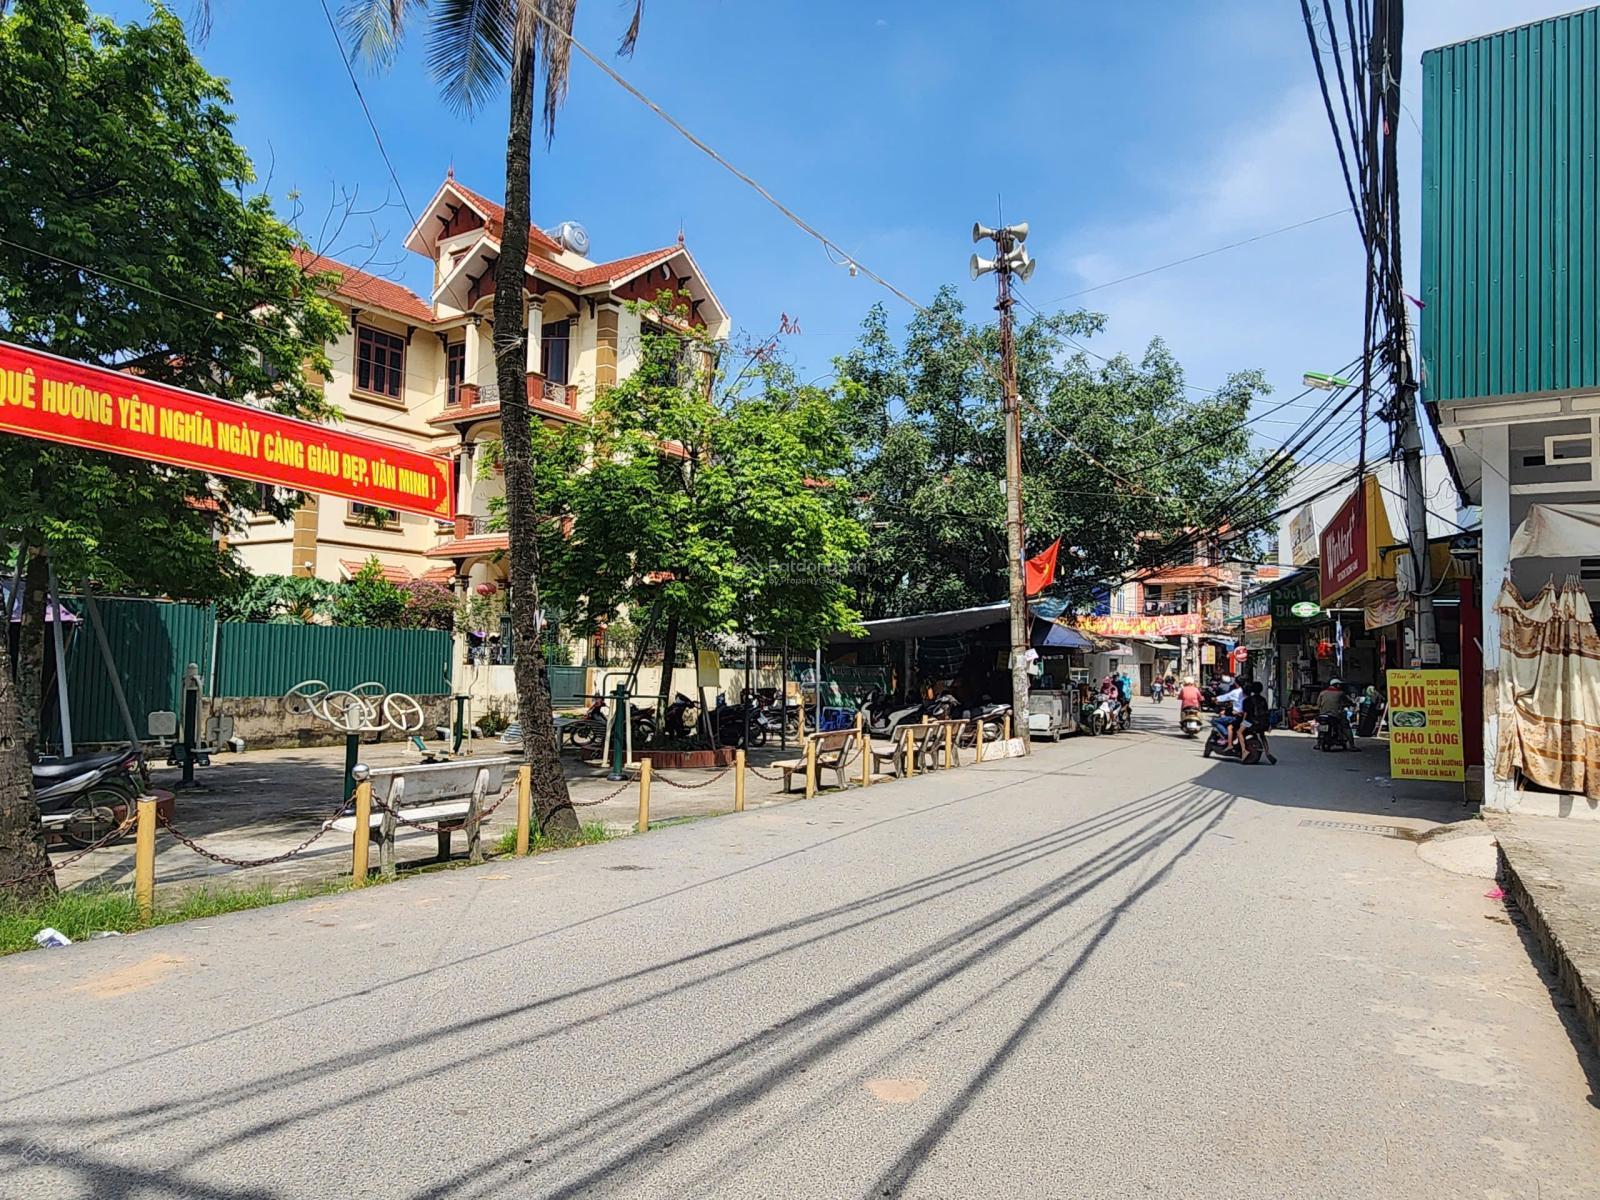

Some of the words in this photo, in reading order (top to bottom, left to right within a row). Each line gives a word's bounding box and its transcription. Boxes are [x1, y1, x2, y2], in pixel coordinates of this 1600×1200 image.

[41, 378, 113, 426] HƯƠNG
[118, 394, 155, 435] YÊN
[160, 408, 214, 448] NGHĨA
[217, 421, 260, 458] NGÀY
[264, 431, 304, 469] CÀNG
[307, 443, 339, 477] GIÀU
[342, 453, 369, 487] ĐẸP,
[371, 458, 396, 489] VĂN
[399, 468, 429, 498] MINH
[1389, 681, 1425, 708] BÚN
[1394, 730, 1425, 744] CHÁO
[1428, 730, 1459, 745] LÒNG
